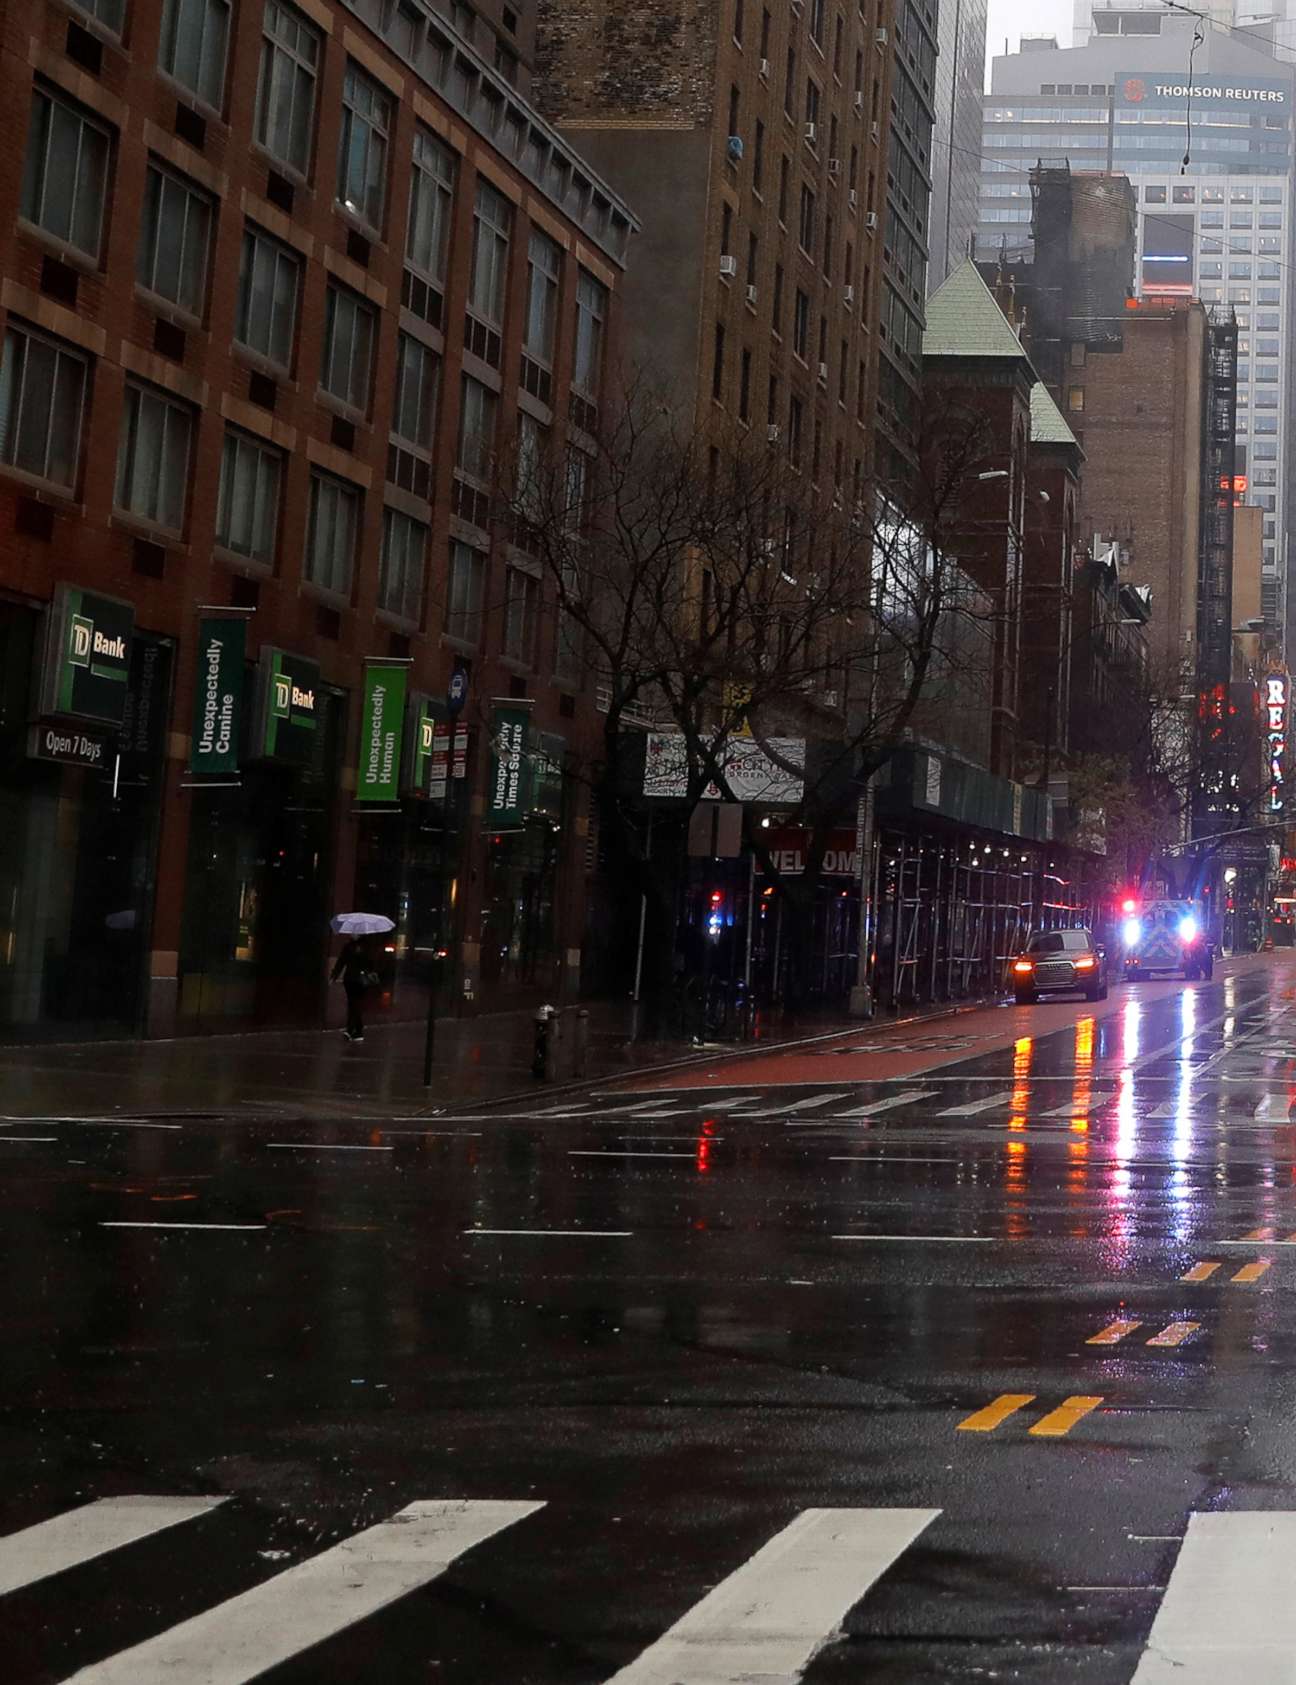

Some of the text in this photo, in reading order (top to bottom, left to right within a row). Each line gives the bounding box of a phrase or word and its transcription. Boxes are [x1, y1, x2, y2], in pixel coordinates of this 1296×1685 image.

[1155, 86, 1284, 102] THOMSON REUTERS
[73, 624, 127, 659] TD Bank
[199, 638, 224, 754] Unexpectedly
[276, 682, 315, 710] TD Bank
[45, 730, 101, 761] Open 7 Days
[216, 693, 234, 754] Canine
[365, 684, 387, 784] Unexpectedly
[1266, 679, 1286, 810] REGAL
[379, 731, 396, 784] Human
[506, 771, 519, 809] Times
